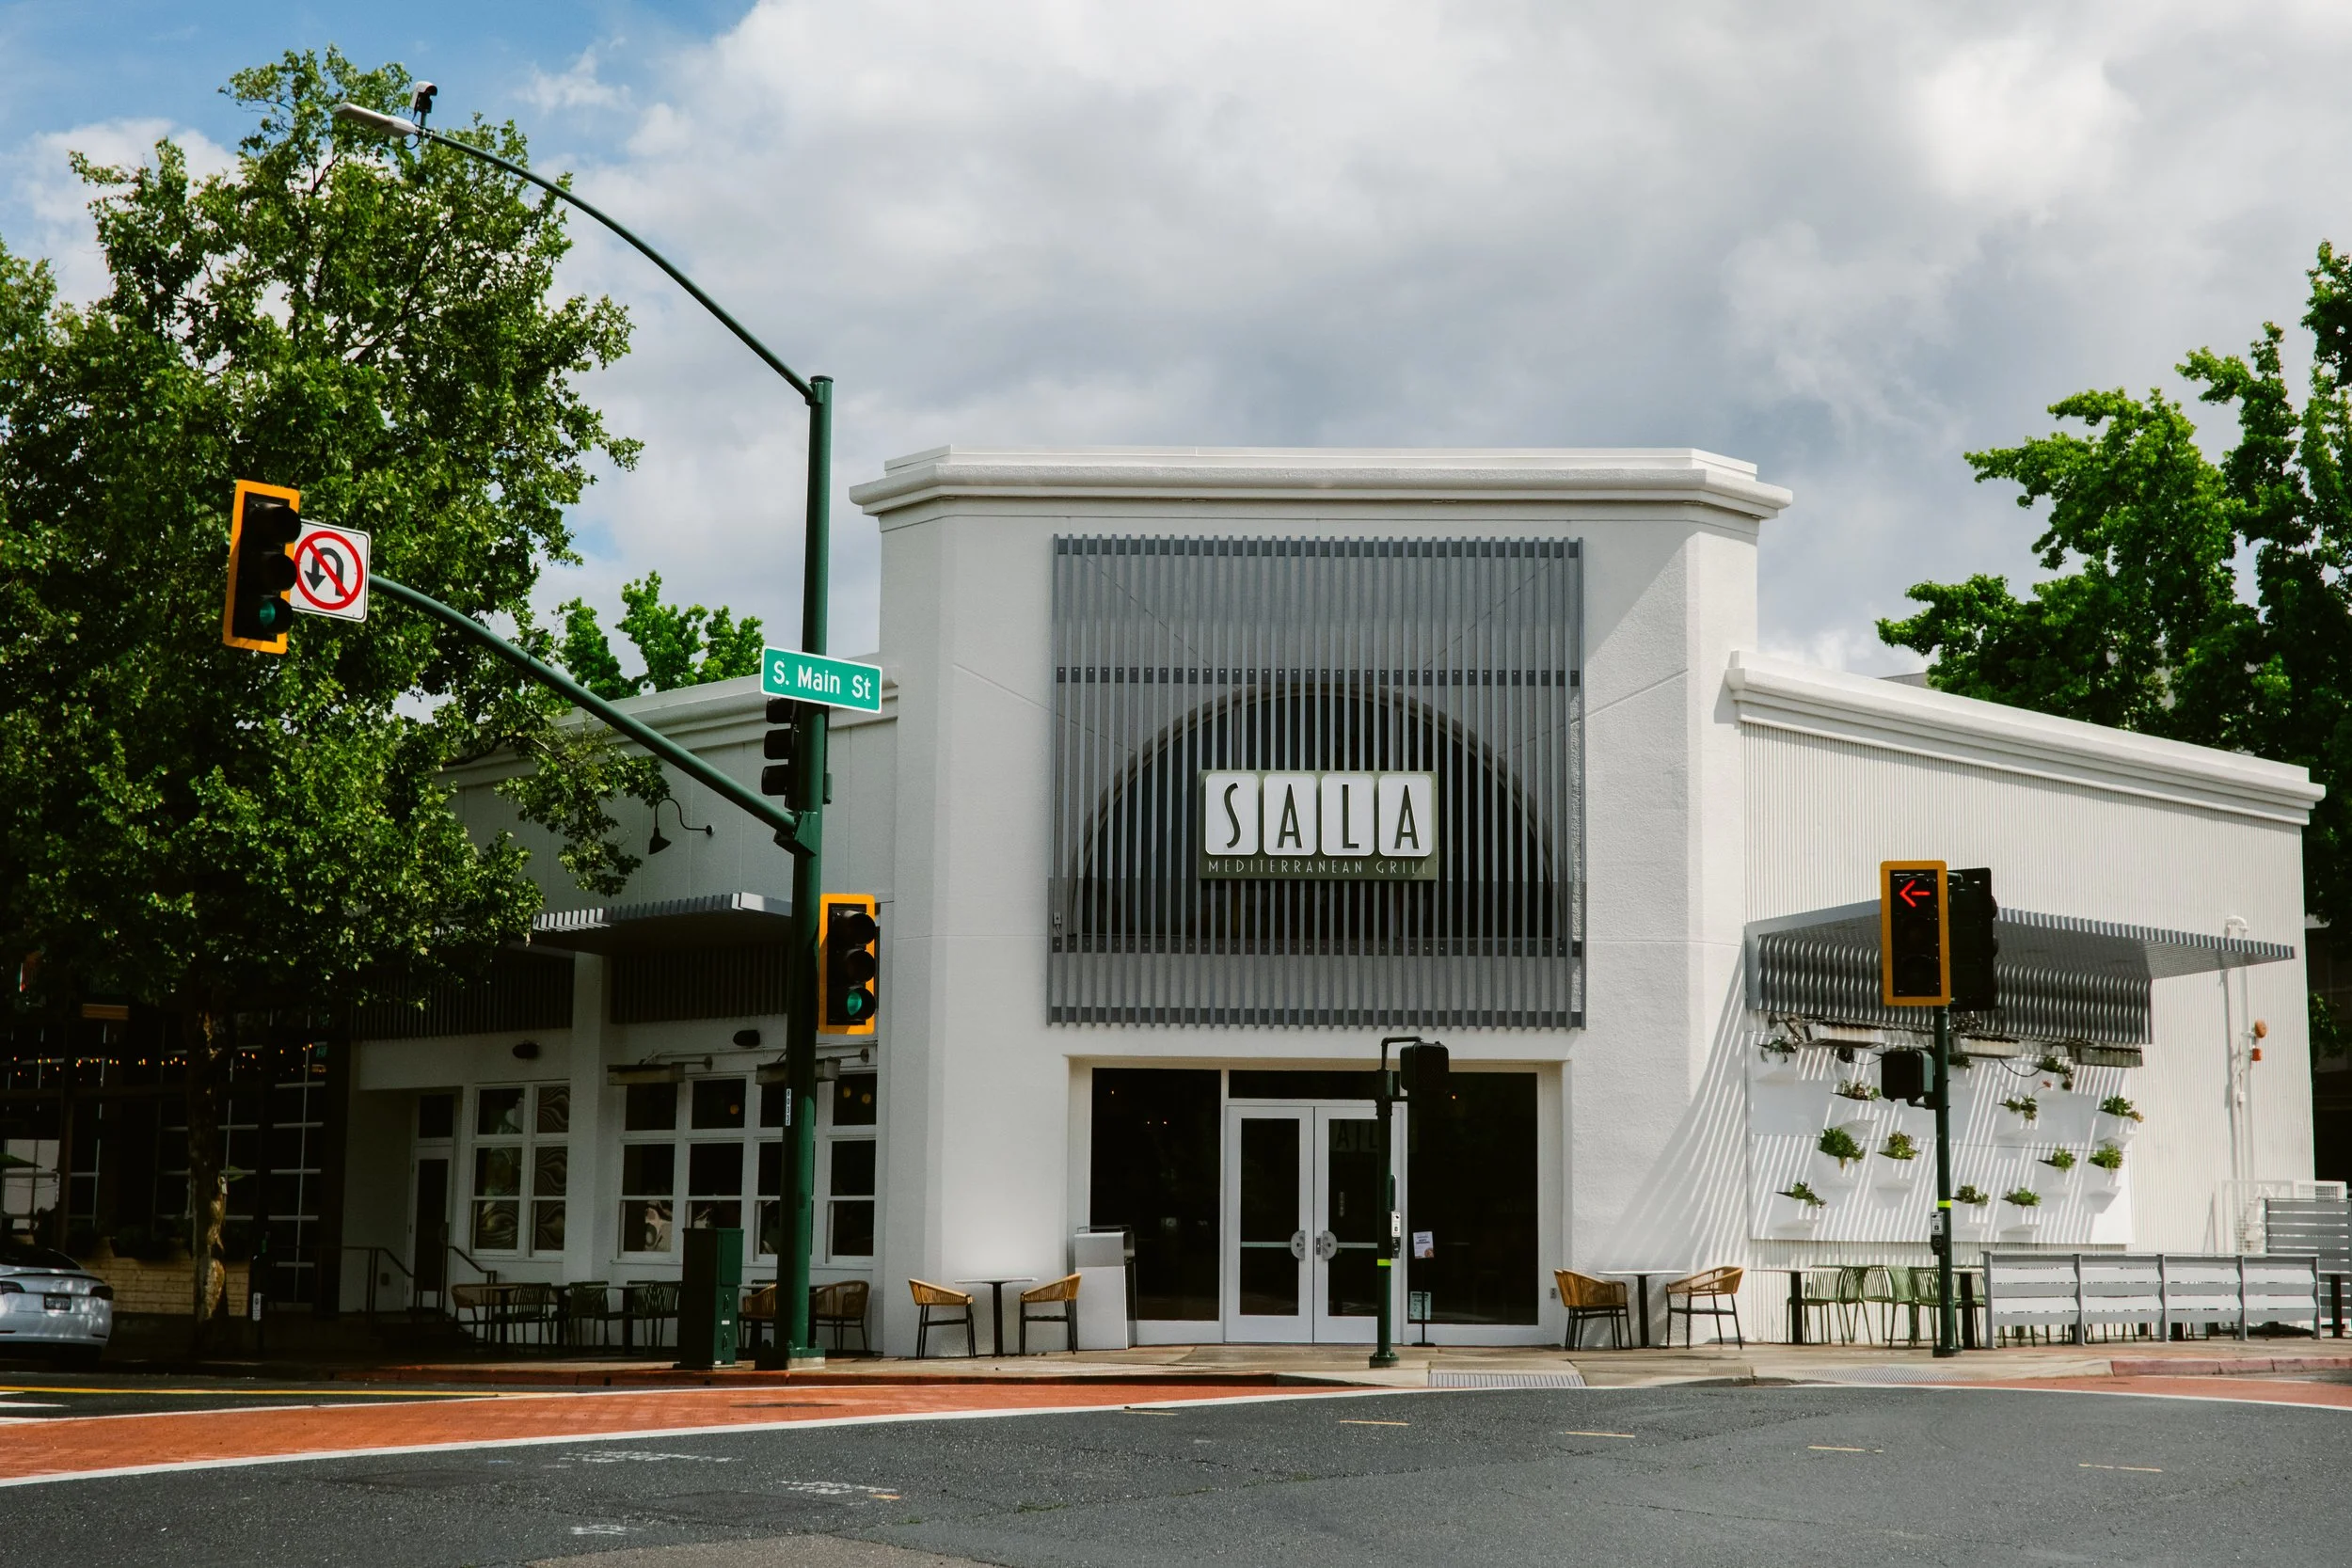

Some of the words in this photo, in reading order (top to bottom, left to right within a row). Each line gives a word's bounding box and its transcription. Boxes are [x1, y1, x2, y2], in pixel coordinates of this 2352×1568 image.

[773, 660, 789, 686] S.
[798, 664, 840, 694] Main
[851, 674, 871, 700] St
[1224, 782, 1419, 849] SALA
[1208, 860, 1362, 873] MEDITERRANEAN
